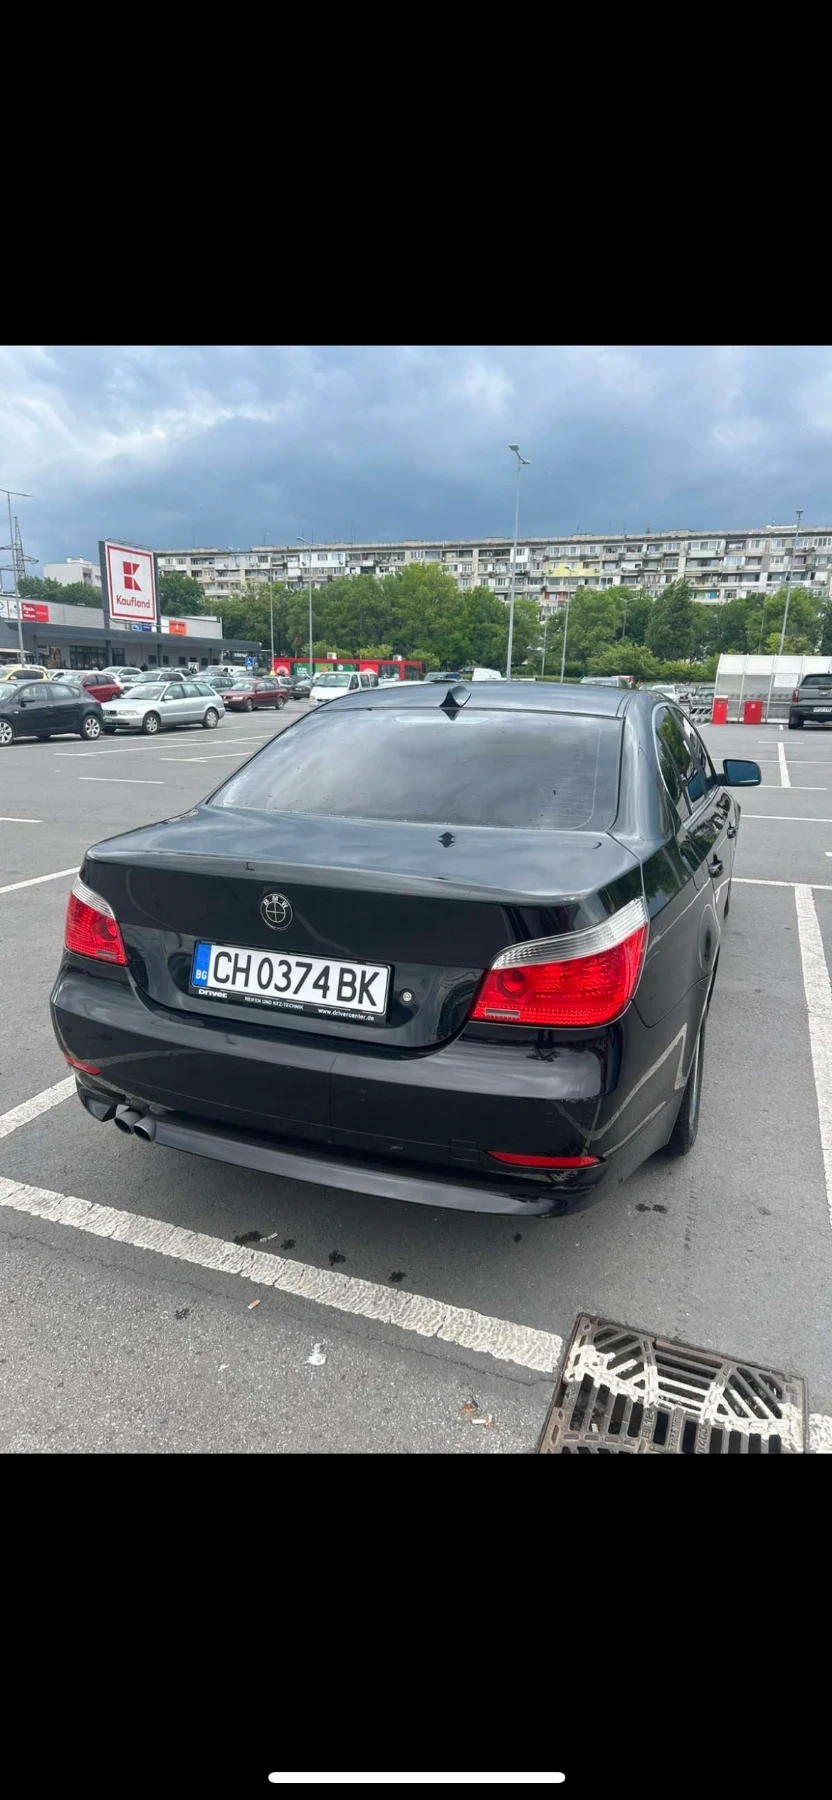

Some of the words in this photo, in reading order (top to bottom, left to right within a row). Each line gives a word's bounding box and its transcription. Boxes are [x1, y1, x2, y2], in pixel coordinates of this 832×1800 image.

[116, 595, 151, 609] Kaufland
[263, 895, 289, 908] BMW
[195, 969, 208, 980] BG
[213, 951, 252, 988] CH
[257, 956, 330, 1000] 0374
[336, 966, 380, 1007] BK
[272, 1000, 304, 1010] KFZ-TECHNIK
[317, 1008, 375, 1021] www.drivercenter.de
